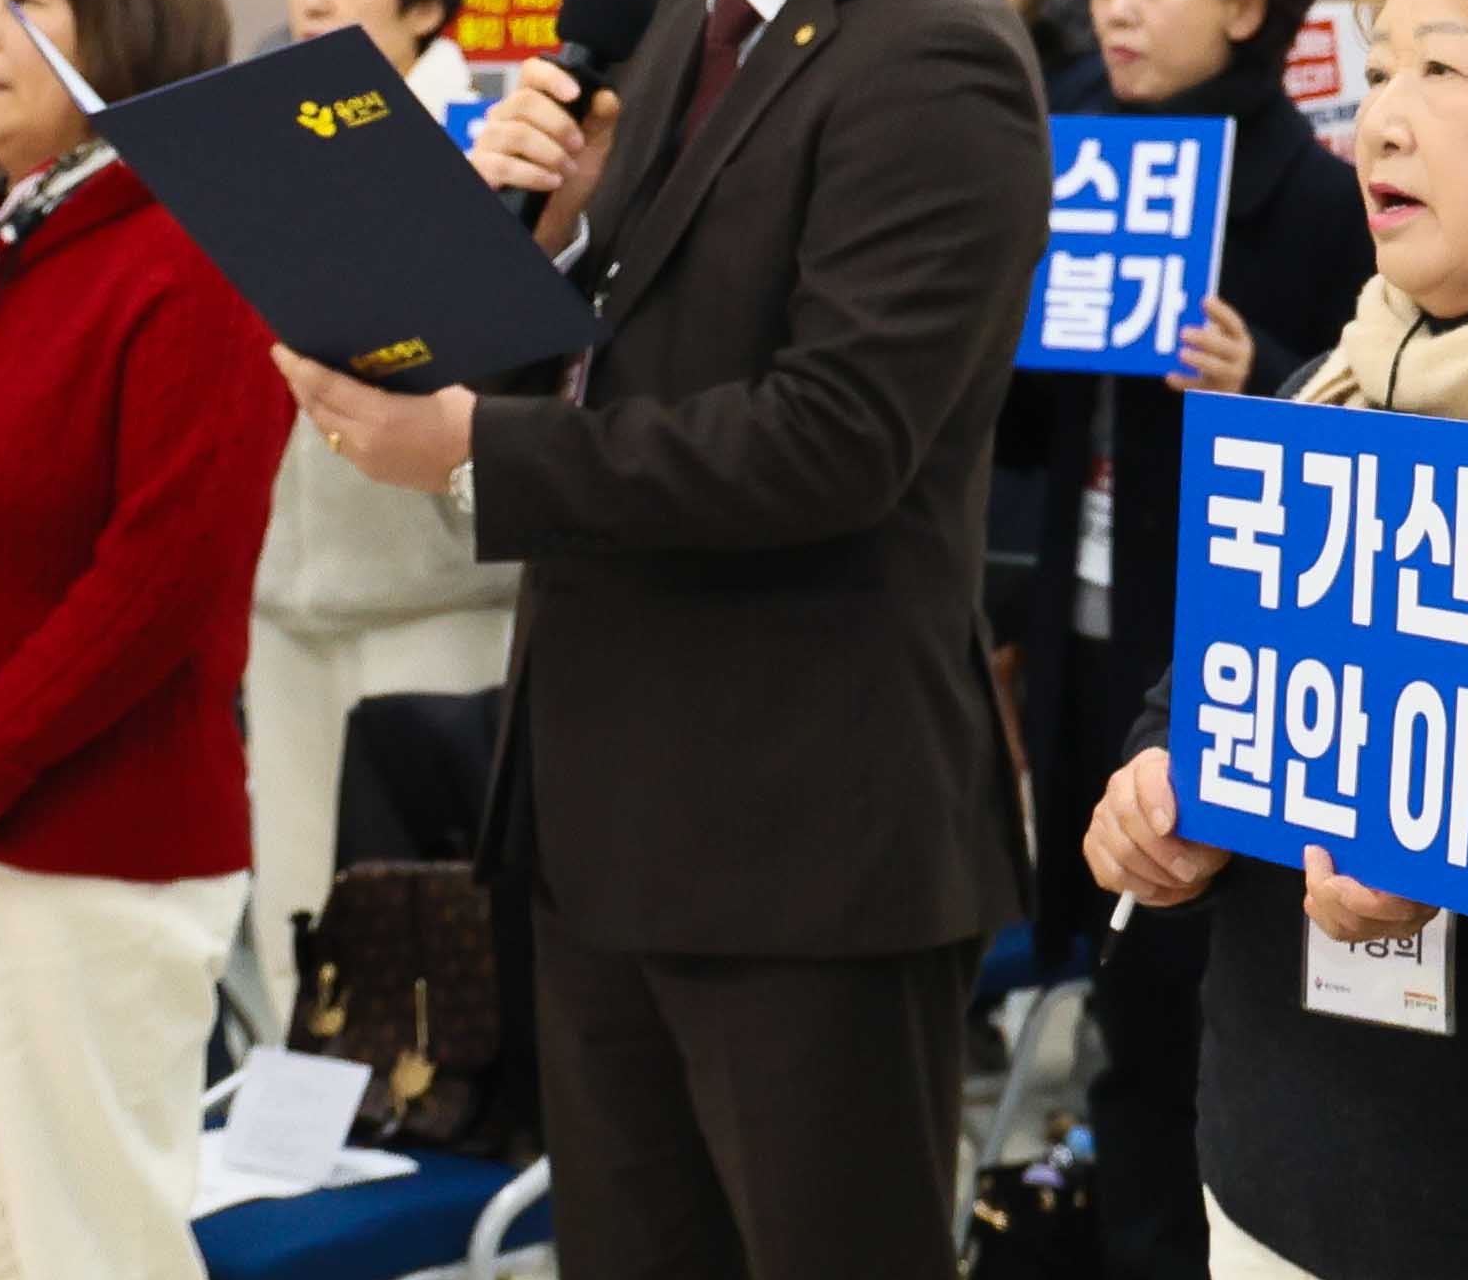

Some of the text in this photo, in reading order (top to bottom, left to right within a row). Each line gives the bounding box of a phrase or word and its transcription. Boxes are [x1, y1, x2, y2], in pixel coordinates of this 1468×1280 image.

[1048, 137, 1201, 239] 스터
[1041, 249, 1187, 355] 불가
[1198, 640, 1368, 839] 원안
